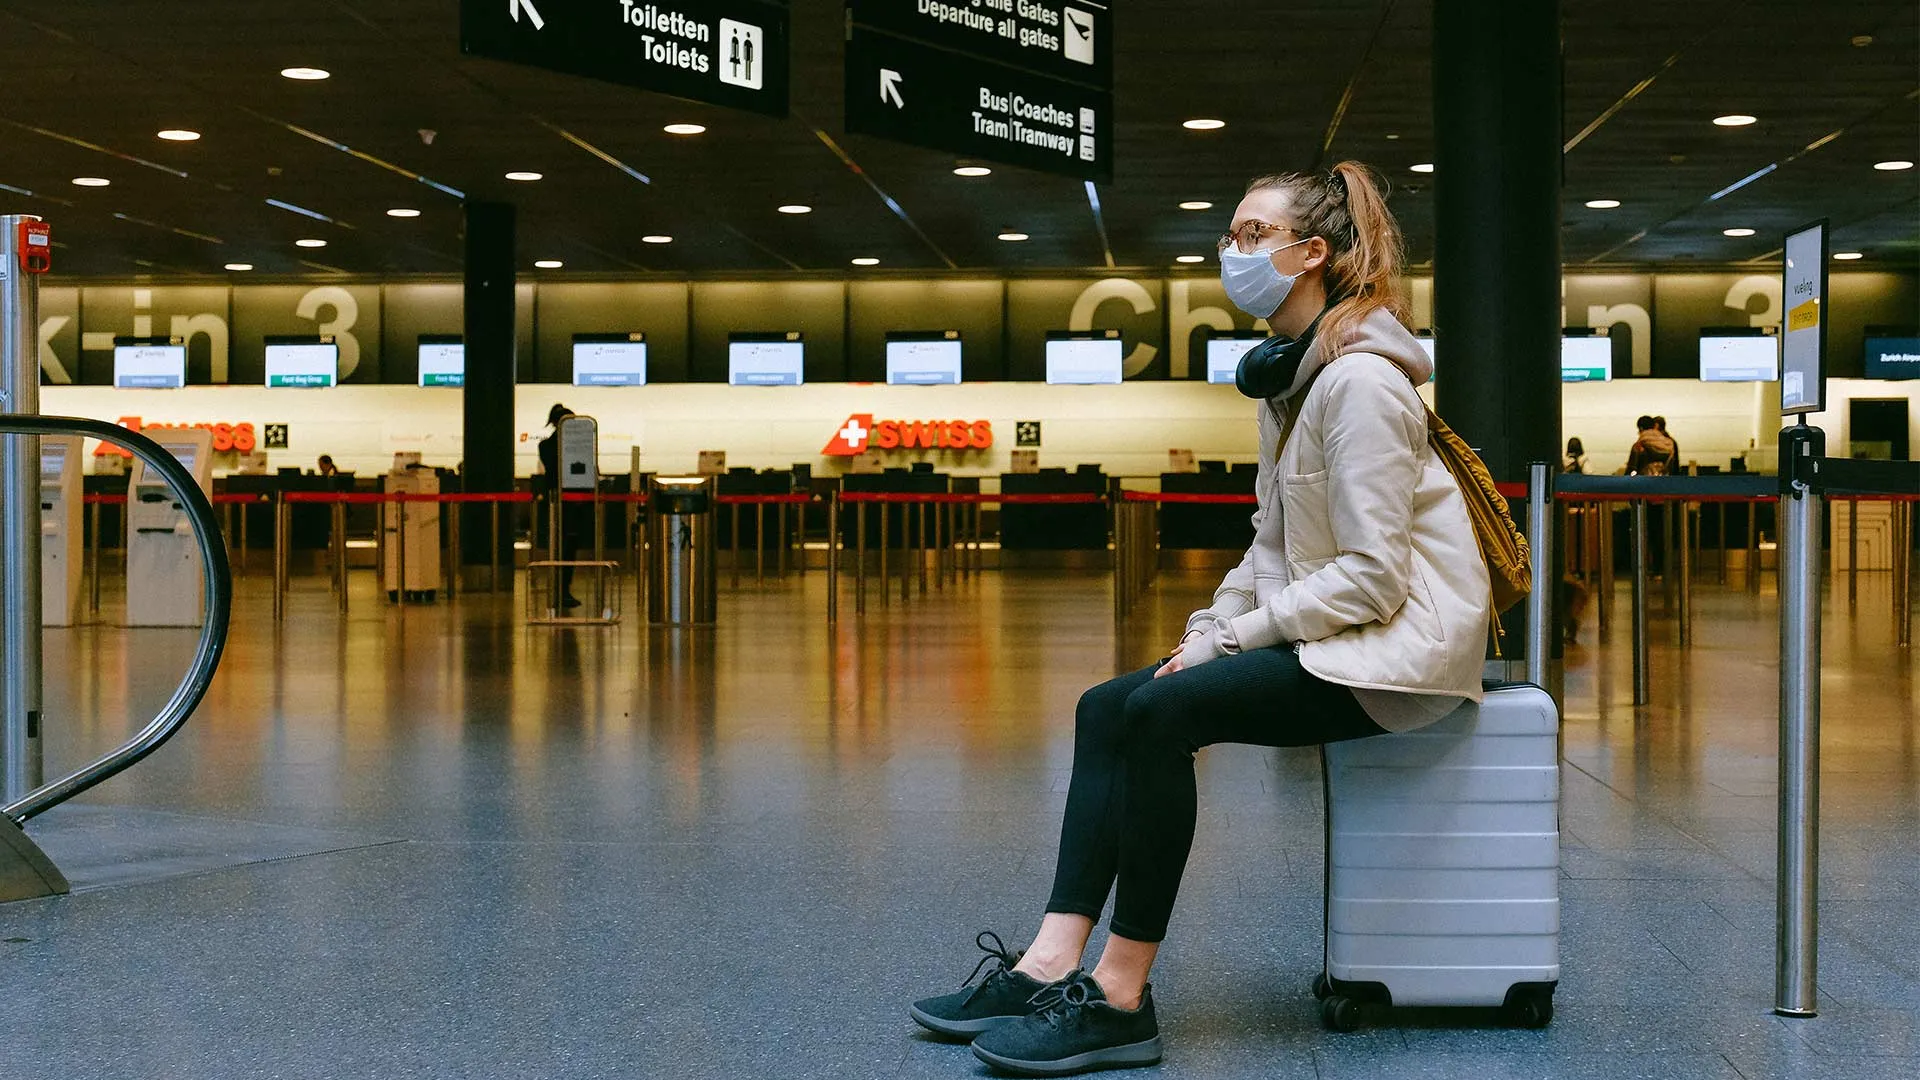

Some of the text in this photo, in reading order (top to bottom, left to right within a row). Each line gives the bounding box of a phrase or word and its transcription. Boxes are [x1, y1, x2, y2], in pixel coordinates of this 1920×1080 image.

[619, 0, 709, 42] Toiletten
[918, 0, 1059, 51] Departure all gates
[1017, 0, 1059, 26] Gates
[641, 34, 709, 73] Toilets
[296, 286, 360, 383] 3
[876, 419, 994, 449] SWISS
